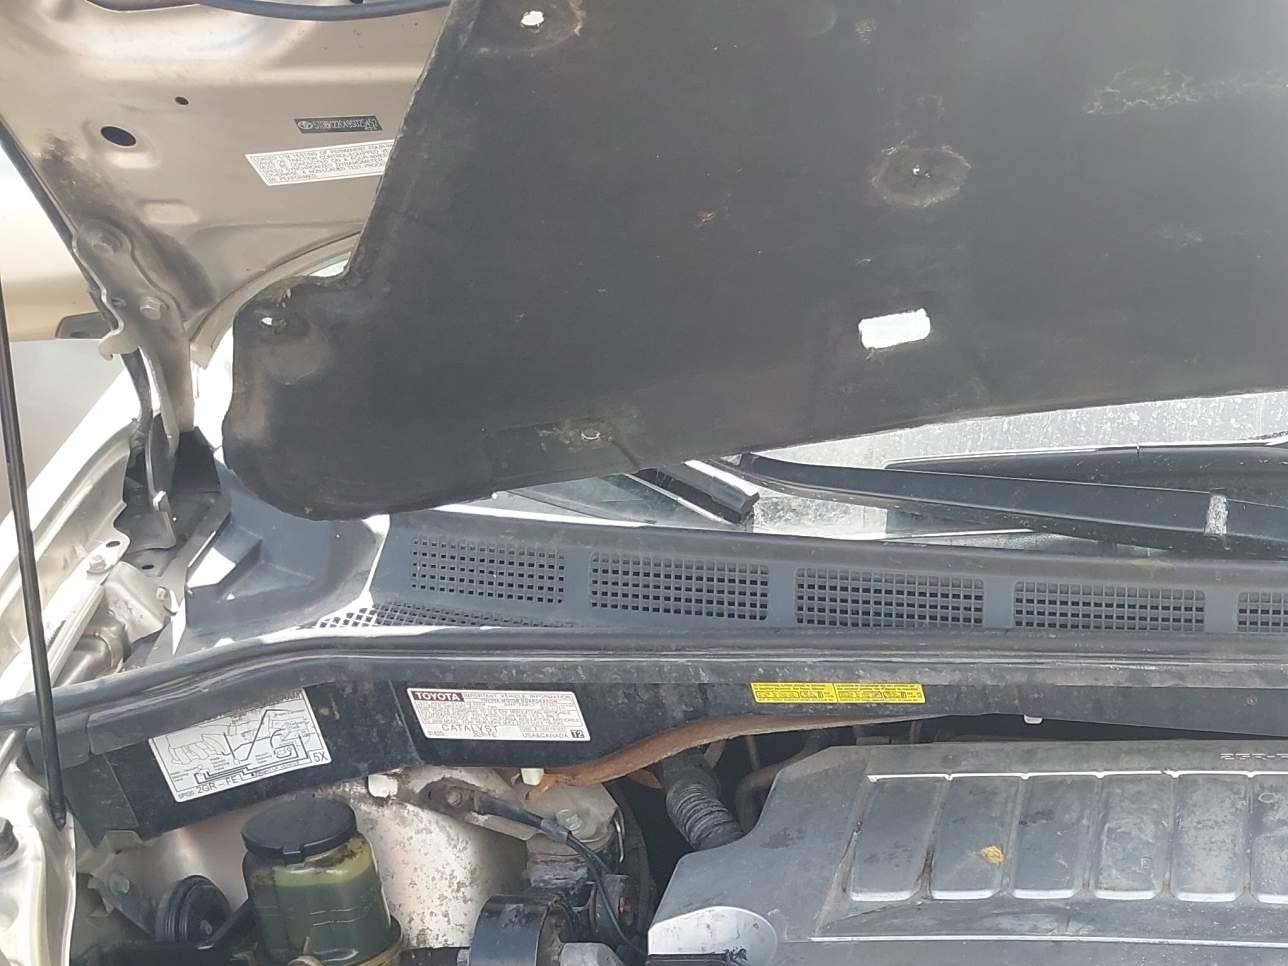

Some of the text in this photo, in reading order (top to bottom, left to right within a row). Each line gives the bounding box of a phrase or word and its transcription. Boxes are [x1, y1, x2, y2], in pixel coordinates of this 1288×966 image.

[415, 692, 461, 701] TOYOTA
[441, 723, 499, 733] CATALYST
[571, 729, 585, 738] T2
[313, 751, 328, 763] 5X
